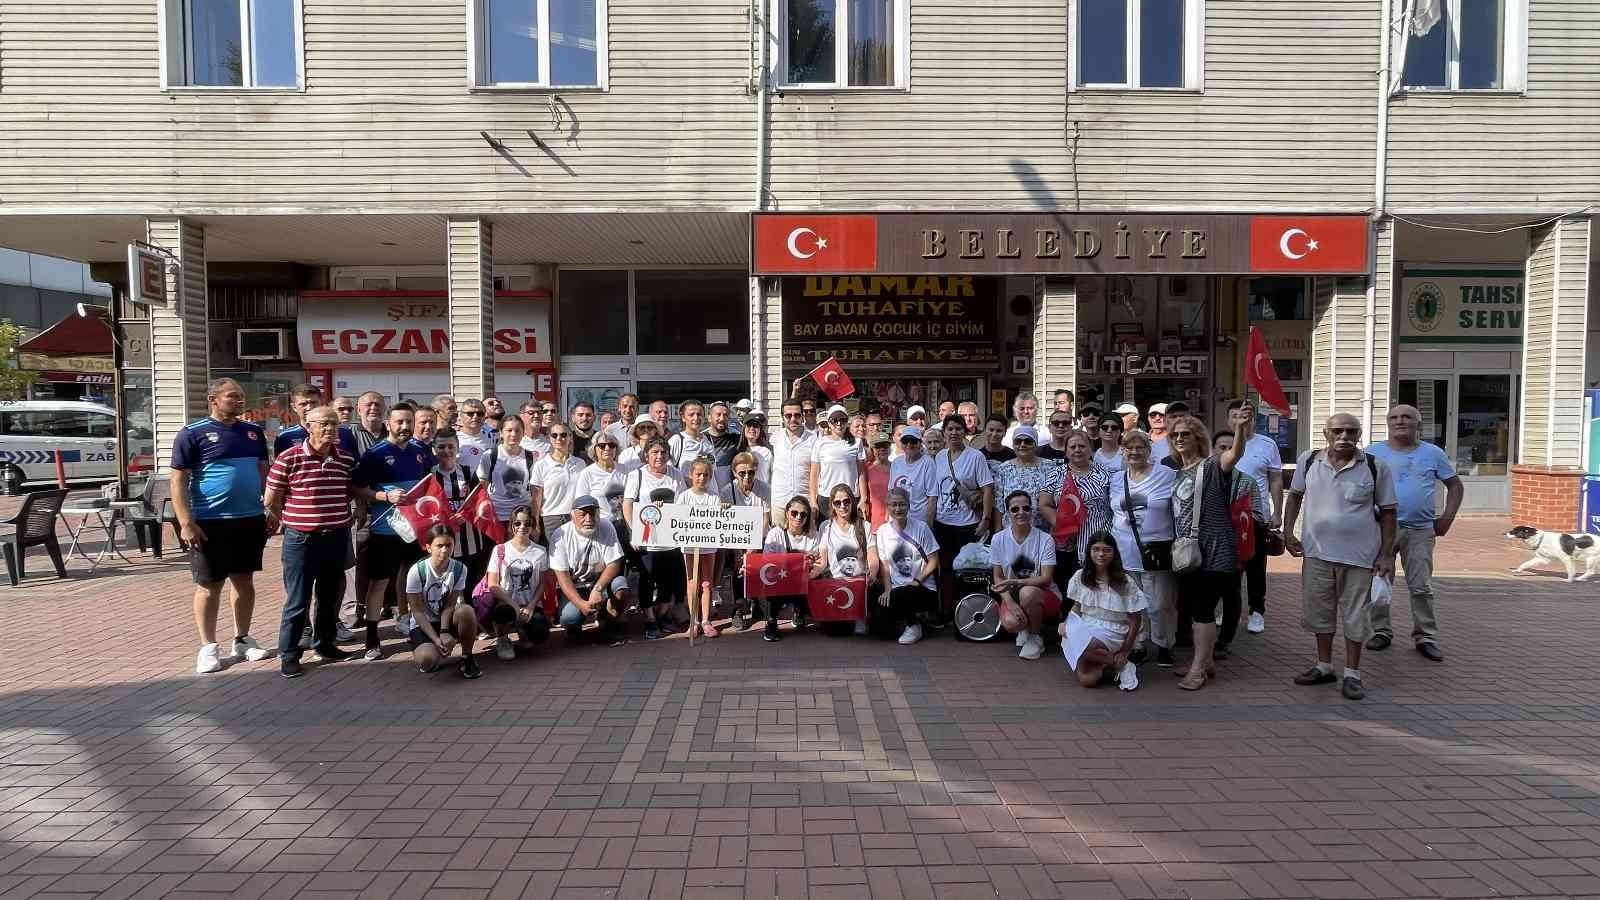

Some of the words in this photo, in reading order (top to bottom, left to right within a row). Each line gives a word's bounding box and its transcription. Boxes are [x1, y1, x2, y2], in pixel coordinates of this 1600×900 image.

[921, 220, 1208, 259] BELEDİYE
[1459, 283, 1523, 305] TAHSİ
[816, 300, 966, 317] TUHAFİYE
[1459, 308, 1522, 329] SERV
[793, 323, 820, 336] BAY
[824, 323, 868, 336] BAYAN
[873, 322, 922, 338] ÇOCUK
[311, 327, 537, 354] ECZANSİ
[86, 452, 116, 462] ZAB
[672, 531, 716, 545] Çaycuma
[719, 533, 751, 547] Şubesi
